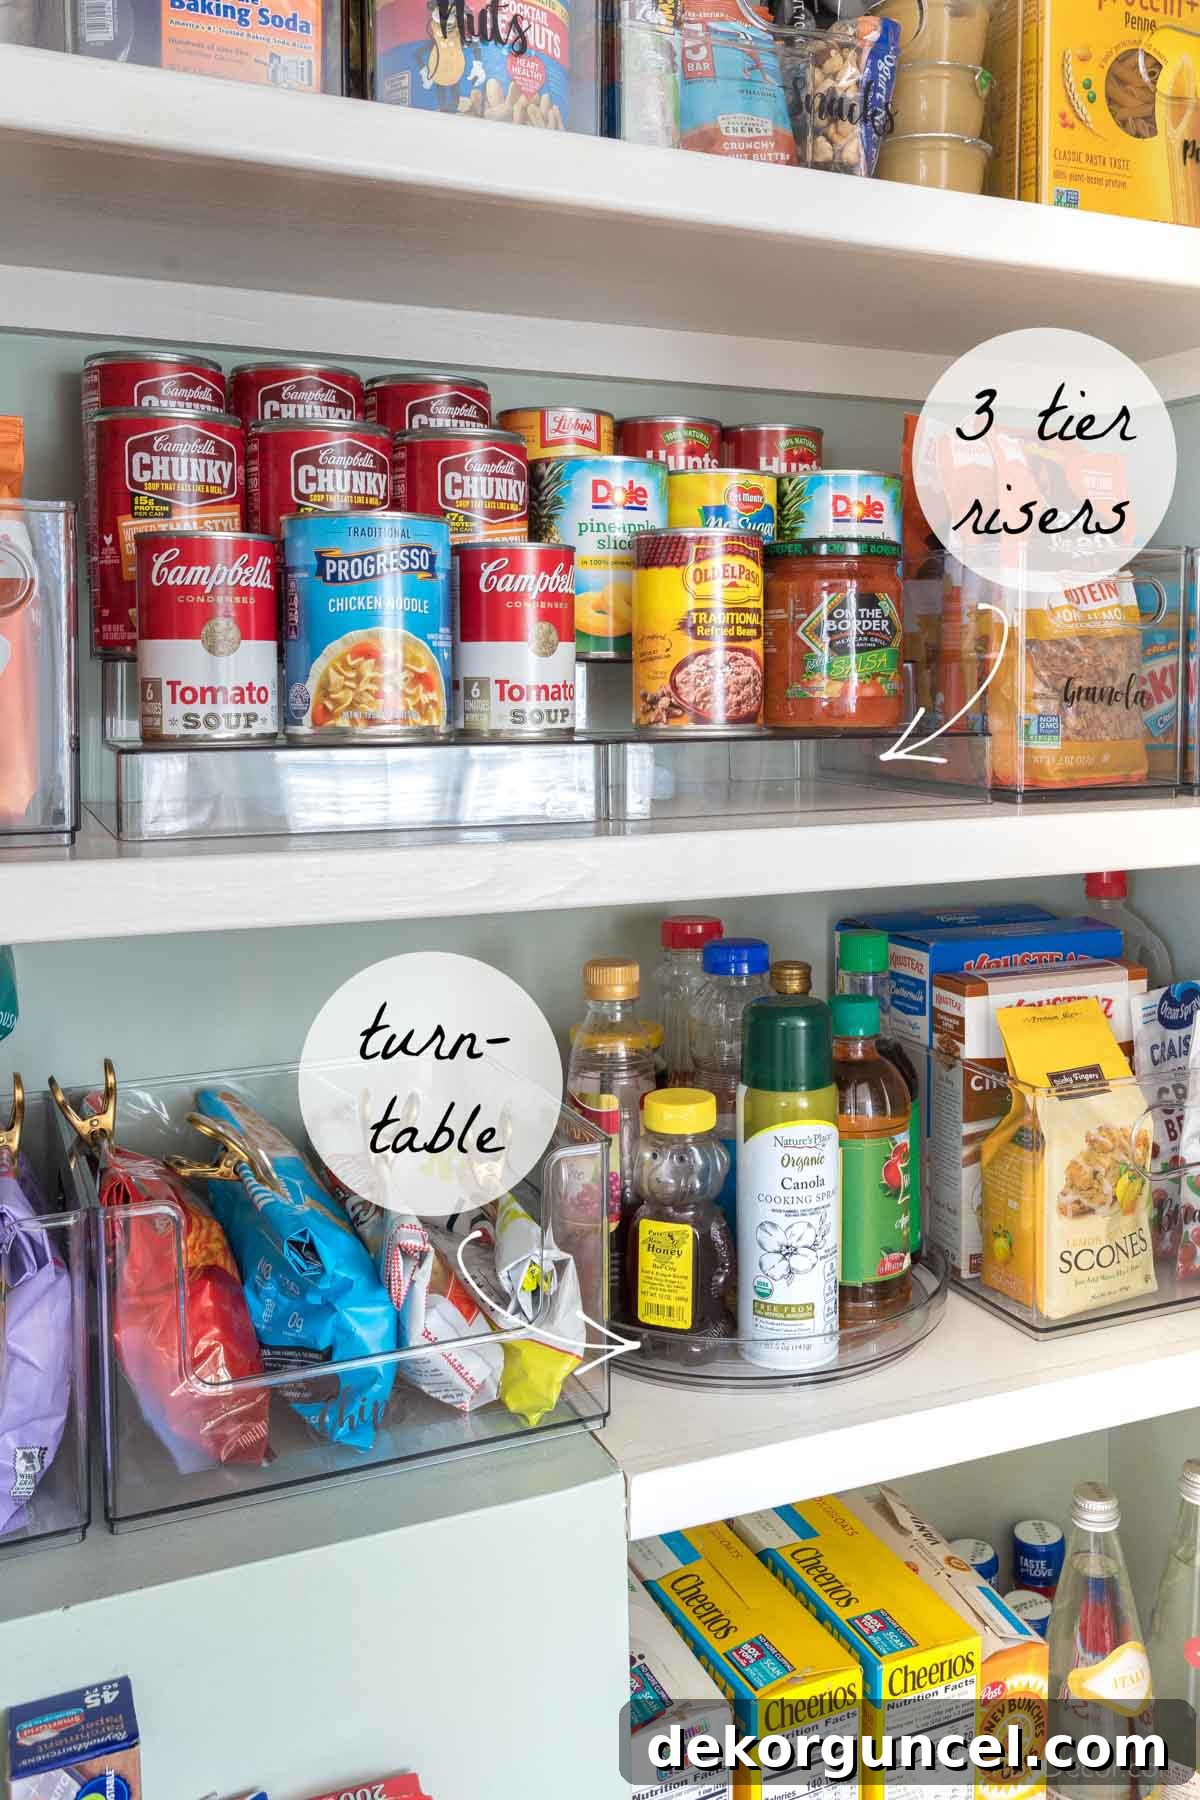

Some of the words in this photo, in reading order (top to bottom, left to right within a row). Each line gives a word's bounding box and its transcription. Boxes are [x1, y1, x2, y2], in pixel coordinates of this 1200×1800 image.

[169, 0, 251, 27] Baking
[257, 7, 312, 34] Soda
[1124, 12, 1157, 33] Penne
[511, 65, 544, 82] HEALTHY
[515, 57, 540, 72] HEART
[687, 62, 711, 72] BAR
[724, 125, 769, 134] ENERGY
[722, 141, 776, 151] CRUNCHY
[160, 379, 213, 402] Campbell's
[281, 383, 337, 404] Campbell's
[430, 397, 478, 418] Campbell's
[552, 415, 593, 436] Libby's
[152, 434, 217, 456] Campbell's
[682, 428, 712, 446] NATURAL
[794, 438, 817, 451] NATURAL
[318, 447, 378, 469] Campbell's
[463, 454, 516, 476] Campbell's
[131, 451, 233, 489] CHUNKY
[297, 464, 388, 503] CHUNKY
[444, 471, 526, 508] CHUNKY
[591, 478, 650, 507] Dole
[133, 495, 155, 506] 15g
[742, 493, 764, 504] Monte
[831, 494, 885, 520] Dole
[347, 526, 412, 539] TRADITIONAL
[151, 547, 274, 594] Campbell's
[324, 548, 431, 581] PROGRESSO
[176, 595, 256, 605] CONDENSED
[327, 595, 382, 614] CHICKEN
[385, 596, 430, 615] NOODLE
[691, 611, 761, 626] TRADITIONAL
[832, 608, 856, 619] ON
[858, 608, 883, 619] THE
[696, 625, 735, 637] Refried
[826, 619, 892, 635] BORDER
[831, 652, 888, 676] SALSA
[145, 682, 154, 700] 6
[165, 679, 270, 706] Tomato
[470, 682, 481, 697] 6
[494, 679, 575, 702] Tomato
[1062, 672, 1149, 711] Granola
[181, 711, 260, 730] SOUP
[510, 708, 569, 725] SOUP
[1039, 715, 1059, 723] NON
[1039, 722, 1060, 730] GMO
[888, 951, 925, 976] KRUSTEAZ
[1159, 999, 1179, 1020] Ocean
[1073, 1072, 1099, 1082] Fingers
[773, 1135, 813, 1147] Nature's
[780, 1151, 825, 1173] Organic
[780, 1174, 826, 1191] Canola
[757, 1192, 813, 1206] COOKING
[647, 1243, 683, 1258] Honey
[1058, 1227, 1148, 1274] SCONES
[1019, 1557, 1047, 1570] TASTE
[1029, 1568, 1054, 1577] LOVE
[790, 1545, 860, 1609] Cheerios
[670, 1571, 738, 1640] Cheerios
[860, 1619, 880, 1635] TOPS
[863, 1613, 883, 1632] BOX
[886, 1630, 906, 1649] SCAN
[738, 1647, 757, 1666] TOPS
[741, 1640, 760, 1659] BOX
[763, 1658, 784, 1677] SCAN
[888, 1651, 975, 1698] Cheerios
[84, 1689, 120, 1709] 45
[886, 1688, 939, 1712] Nutrition
[944, 1678, 975, 1694] Facts
[981, 1685, 1003, 1701] Post
[764, 1682, 858, 1732] Cheerios
[824, 1710, 857, 1727] Facts
[1008, 1698, 1046, 1739] BUNCHES
[72, 1731, 129, 1752] Reynolds
[631, 1778, 688, 1800] Nutrition
[693, 1761, 727, 1783] Facts
